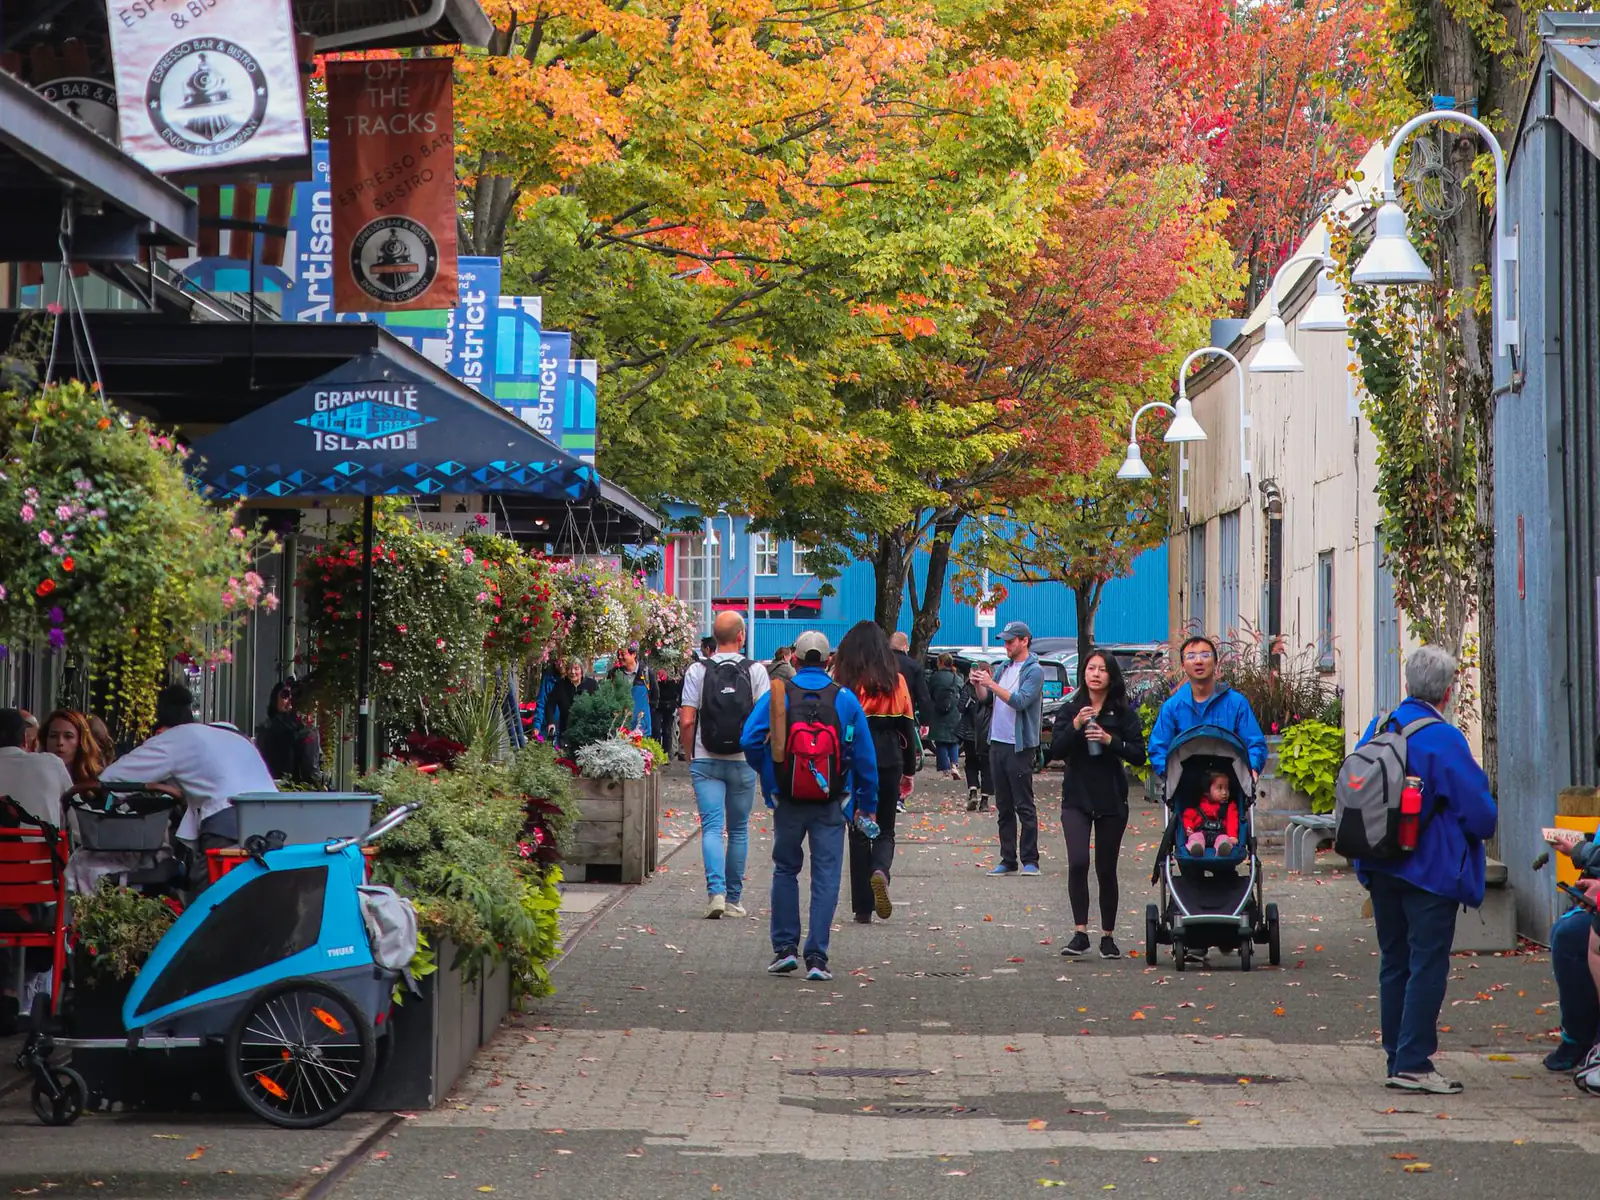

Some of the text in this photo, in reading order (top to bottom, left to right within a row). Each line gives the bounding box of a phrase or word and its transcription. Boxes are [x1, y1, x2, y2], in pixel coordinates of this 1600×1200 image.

[170, 12, 190, 29] &
[151, 40, 257, 84] ESPRESSO BAR & BISTRO
[365, 62, 410, 81] OFF
[61, 83, 89, 97] BAR
[93, 87, 105, 100] &
[366, 86, 410, 108] THE
[344, 112, 438, 136] TRACKS
[161, 120, 259, 155] ENJOY THE COMPANY
[337, 132, 451, 207] ESPRESSO BAR
[372, 168, 434, 211] & BISTRO
[297, 190, 332, 322] Artisan
[314, 390, 418, 411] GRANVILLE
[539, 357, 558, 436] istrict
[313, 430, 405, 451] ISLAND
[327, 945, 354, 957] THULE
